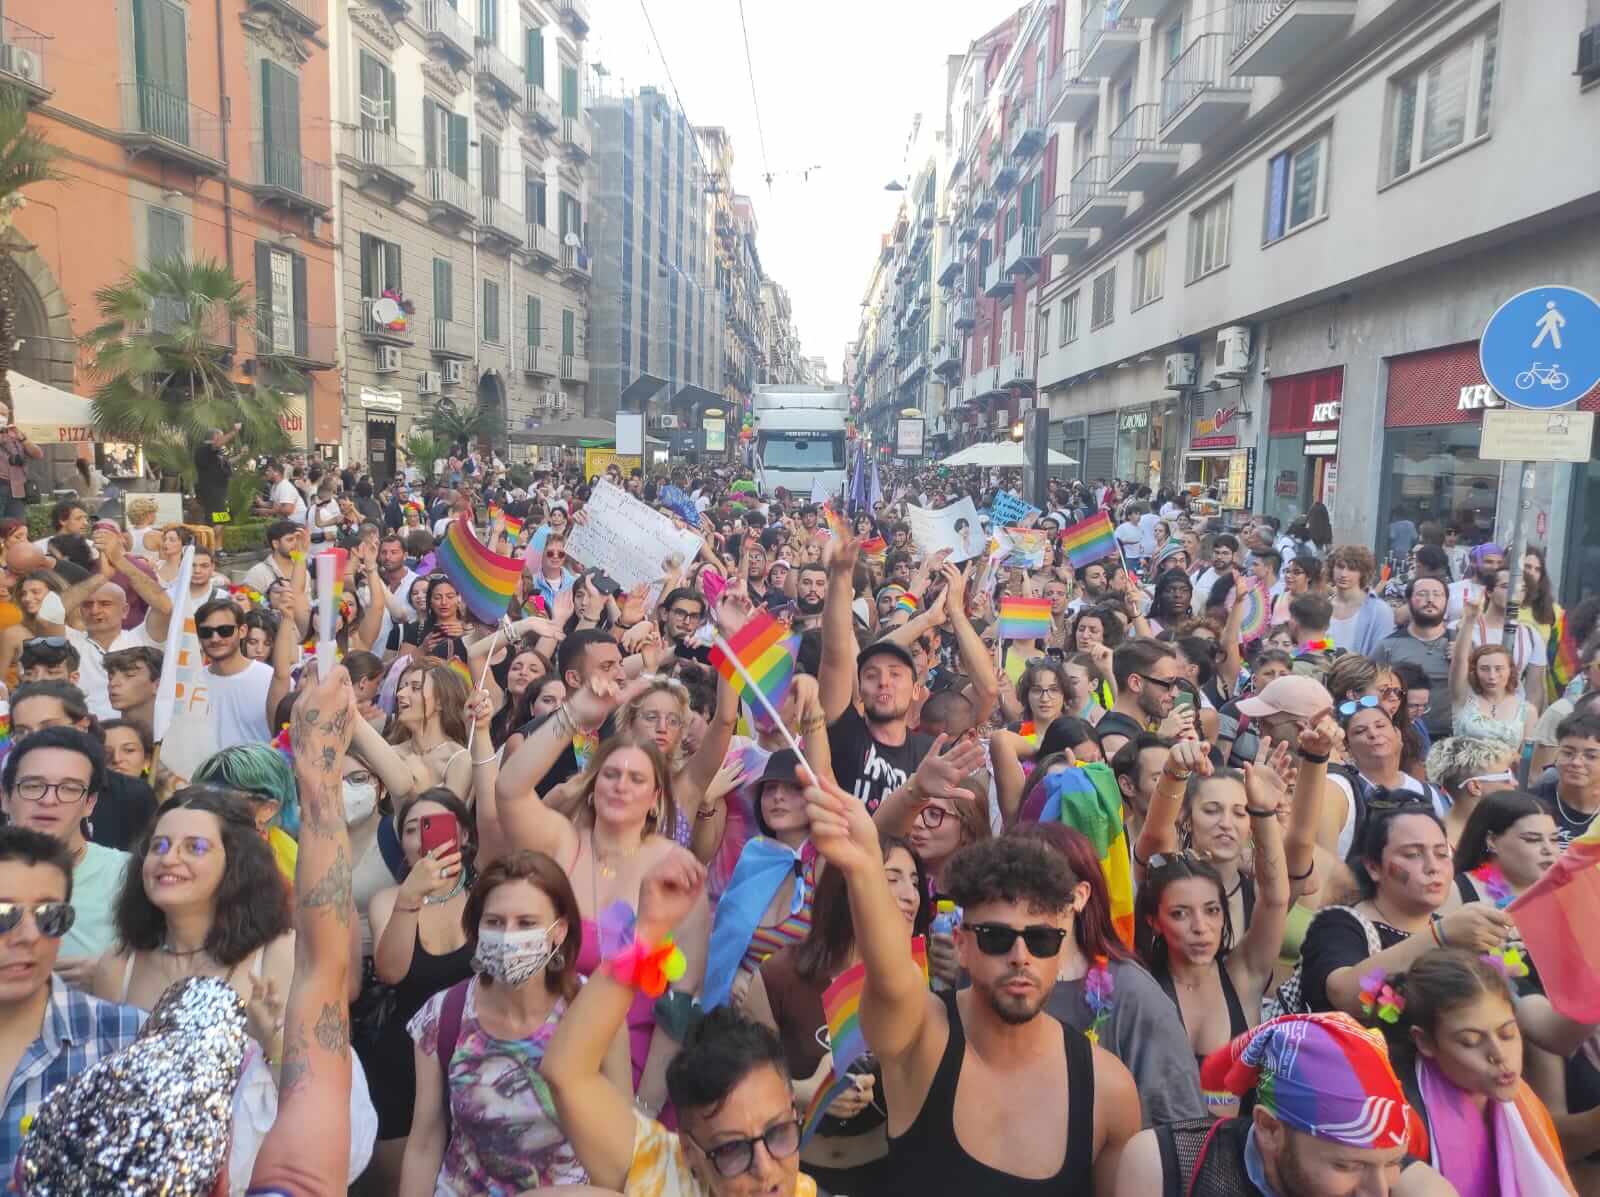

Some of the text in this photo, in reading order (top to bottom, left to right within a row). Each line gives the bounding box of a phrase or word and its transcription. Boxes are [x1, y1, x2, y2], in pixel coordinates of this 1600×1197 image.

[1457, 383, 1497, 409] KFC
[1312, 402, 1338, 422] KFC
[58, 427, 95, 441] PIZZA
